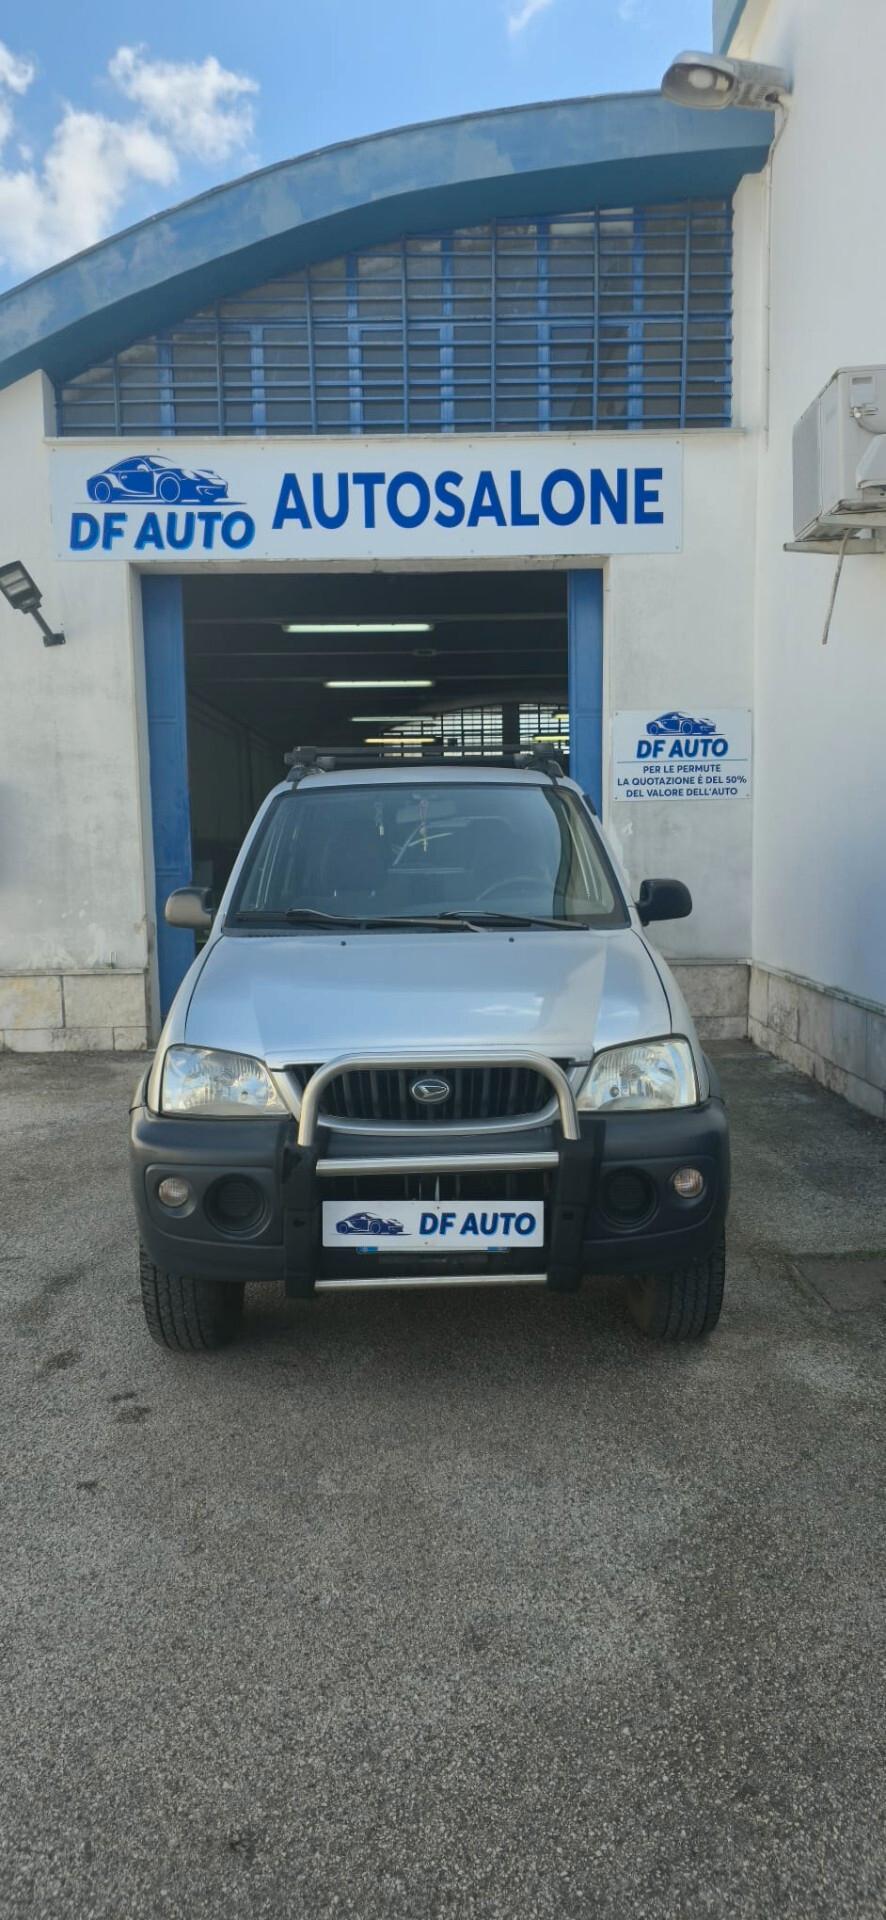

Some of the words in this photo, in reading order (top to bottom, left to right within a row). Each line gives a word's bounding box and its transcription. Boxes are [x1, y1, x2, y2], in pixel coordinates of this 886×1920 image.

[272, 467, 664, 530] AUTOSALONE
[69, 512, 128, 551] DF
[134, 510, 256, 550] AUTO
[636, 739, 666, 759] DF
[668, 738, 729, 758] AUTO
[643, 765, 660, 774] PER
[664, 765, 675, 773] LE
[677, 764, 721, 773] PERMUTE
[617, 778, 629, 786] LA
[632, 776, 695, 786] QUOTAZIONE
[706, 776, 723, 784] DEL
[726, 775, 747, 784] 50%
[626, 789, 644, 798] DEL
[646, 788, 684, 797] VALORE
[686, 787, 738, 796] DELL'AUTO
[419, 1212, 457, 1235] DF
[460, 1212, 536, 1236] AUTO
